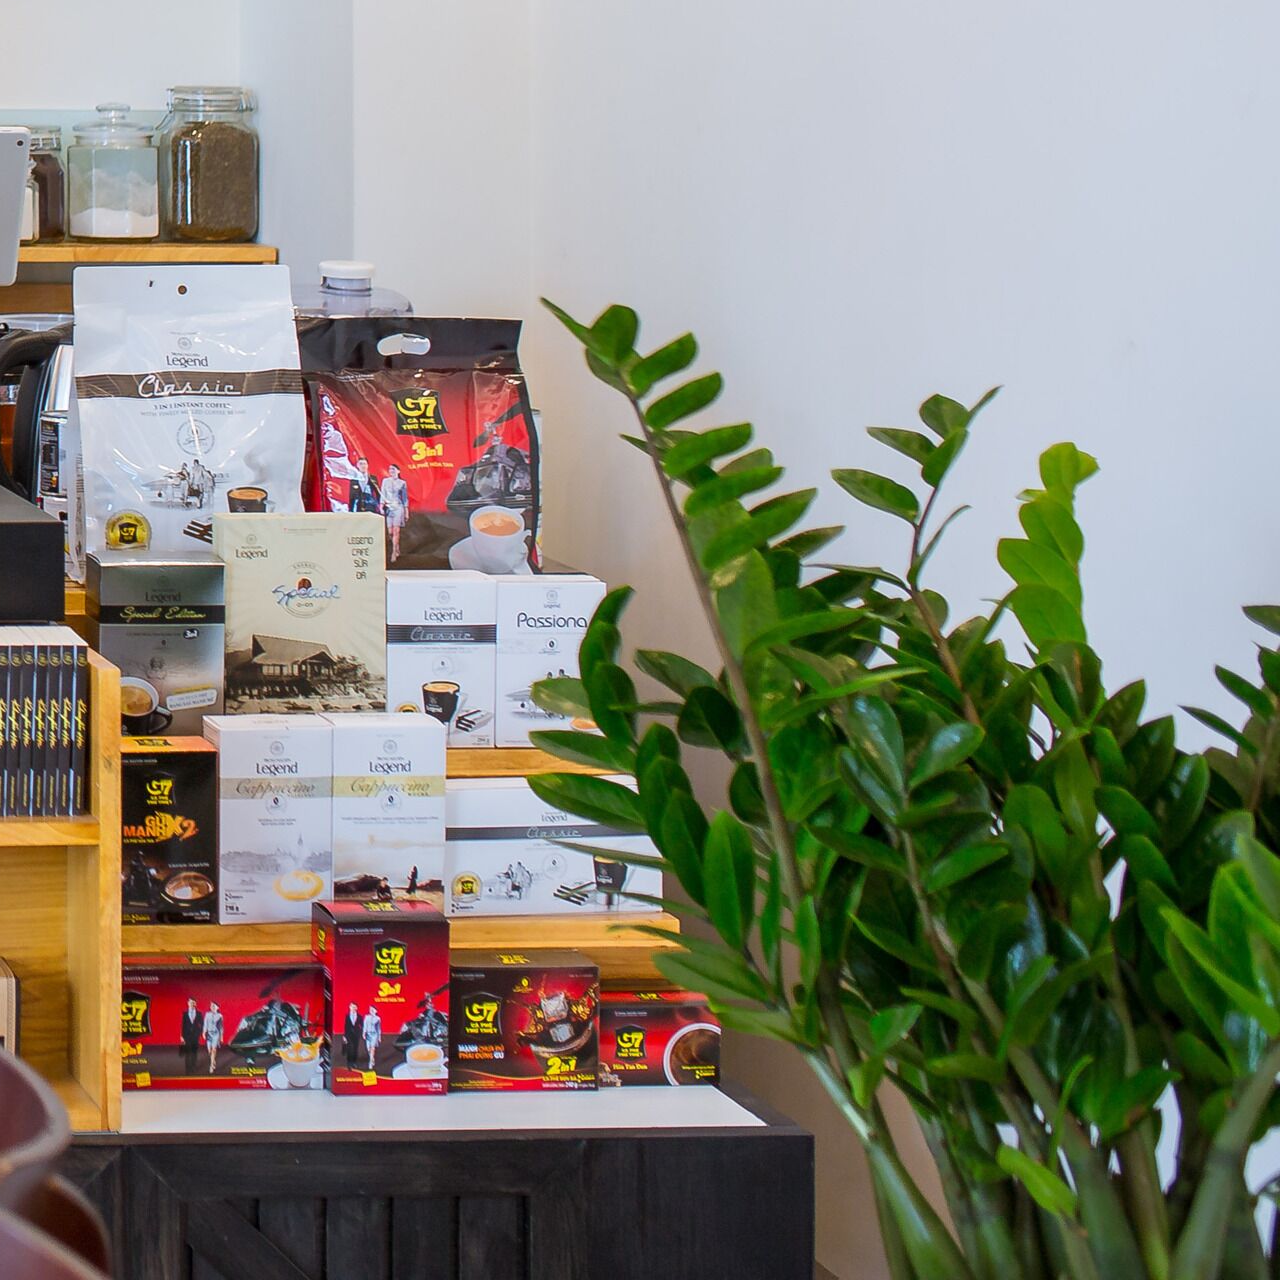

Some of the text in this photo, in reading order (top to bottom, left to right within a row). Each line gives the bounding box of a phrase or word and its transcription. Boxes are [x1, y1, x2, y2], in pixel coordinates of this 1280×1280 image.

[166, 354, 209, 369] Legend
[138, 373, 242, 398] Classic
[235, 548, 269, 560] Legend
[424, 609, 463, 623] Legend
[256, 762, 299, 776] Legend
[369, 760, 412, 775] Legend
